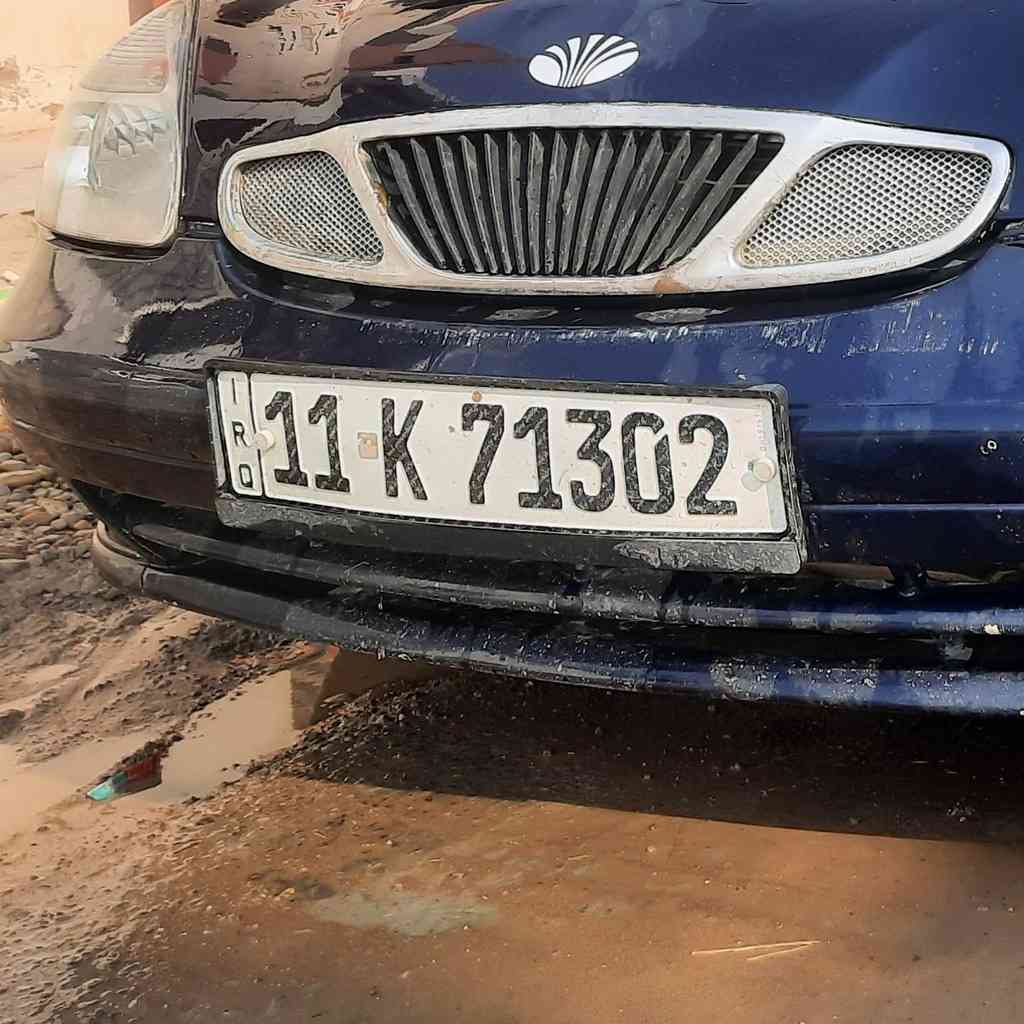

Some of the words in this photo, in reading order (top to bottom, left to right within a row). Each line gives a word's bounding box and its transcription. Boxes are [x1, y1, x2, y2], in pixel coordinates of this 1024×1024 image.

[264, 391, 350, 493] 11
[381, 397, 428, 501] K
[461, 402, 738, 516] 71302
